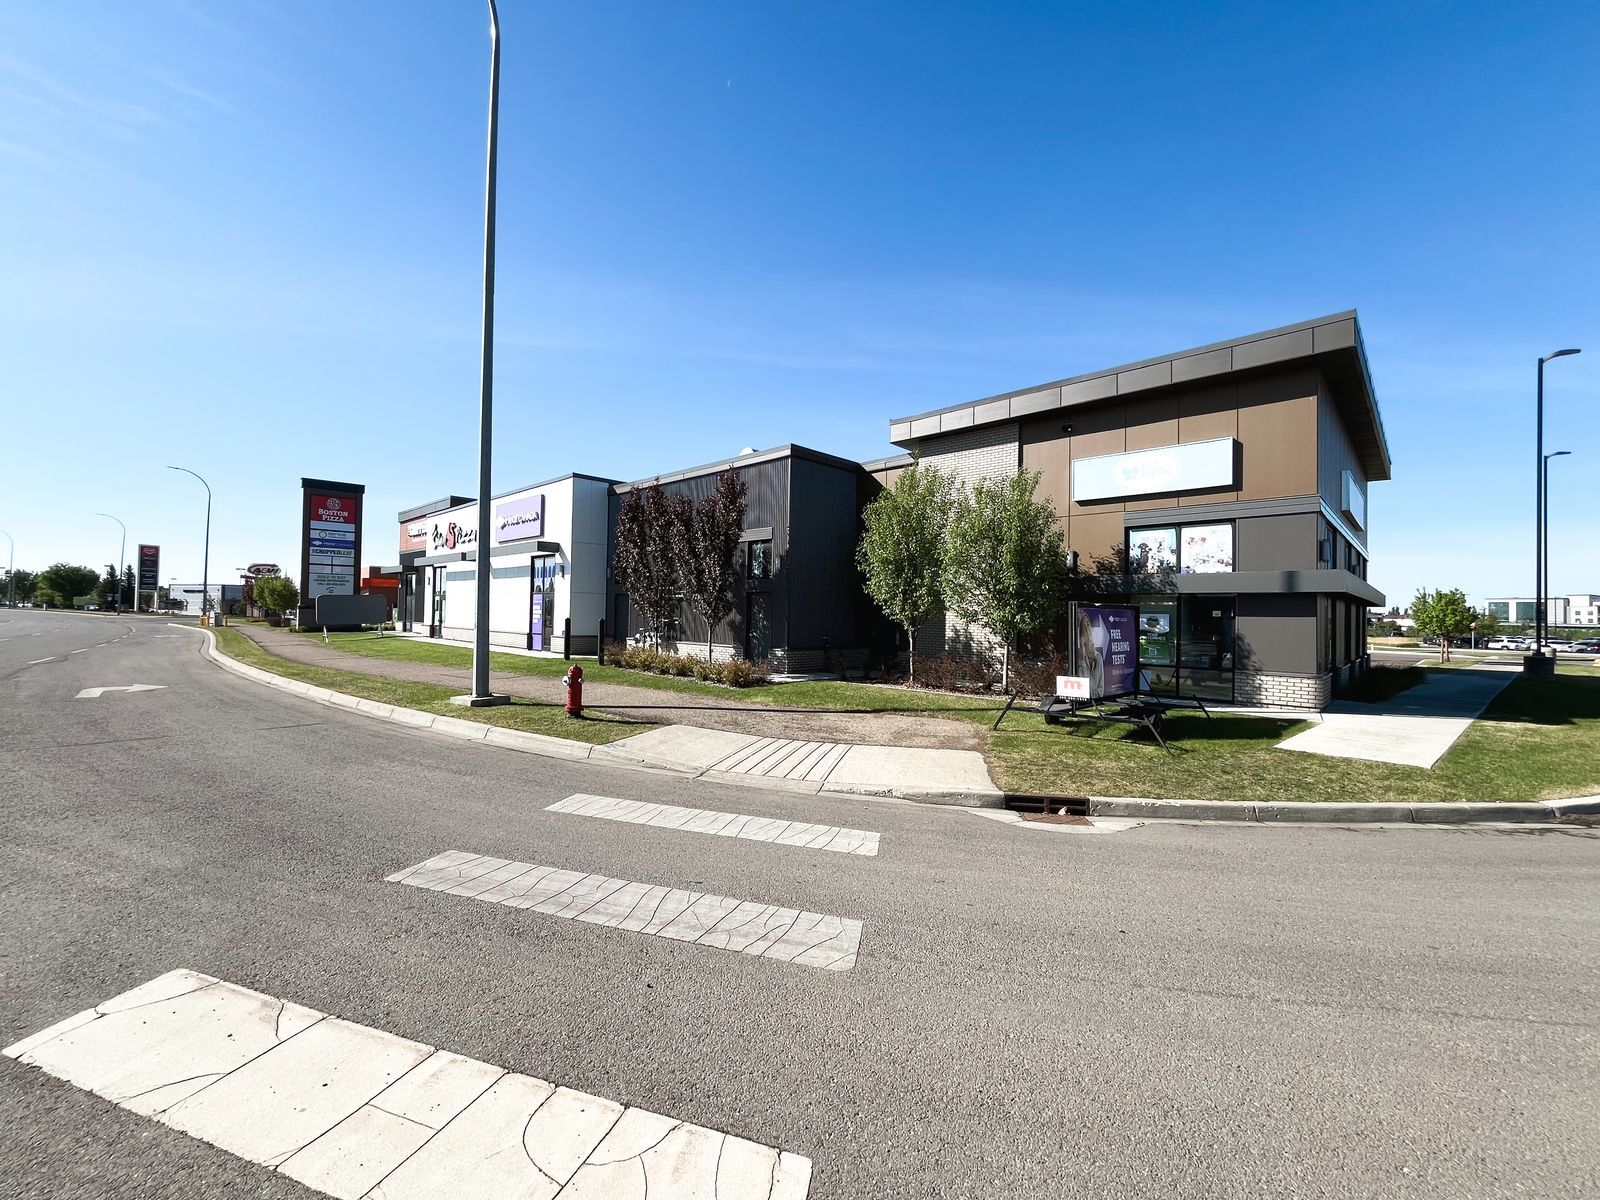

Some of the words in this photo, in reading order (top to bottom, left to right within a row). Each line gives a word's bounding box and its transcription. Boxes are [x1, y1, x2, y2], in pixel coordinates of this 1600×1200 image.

[318, 509, 348, 517] BOSTON
[1110, 629, 1121, 640] FREE
[1111, 641, 1130, 653] HEARING
